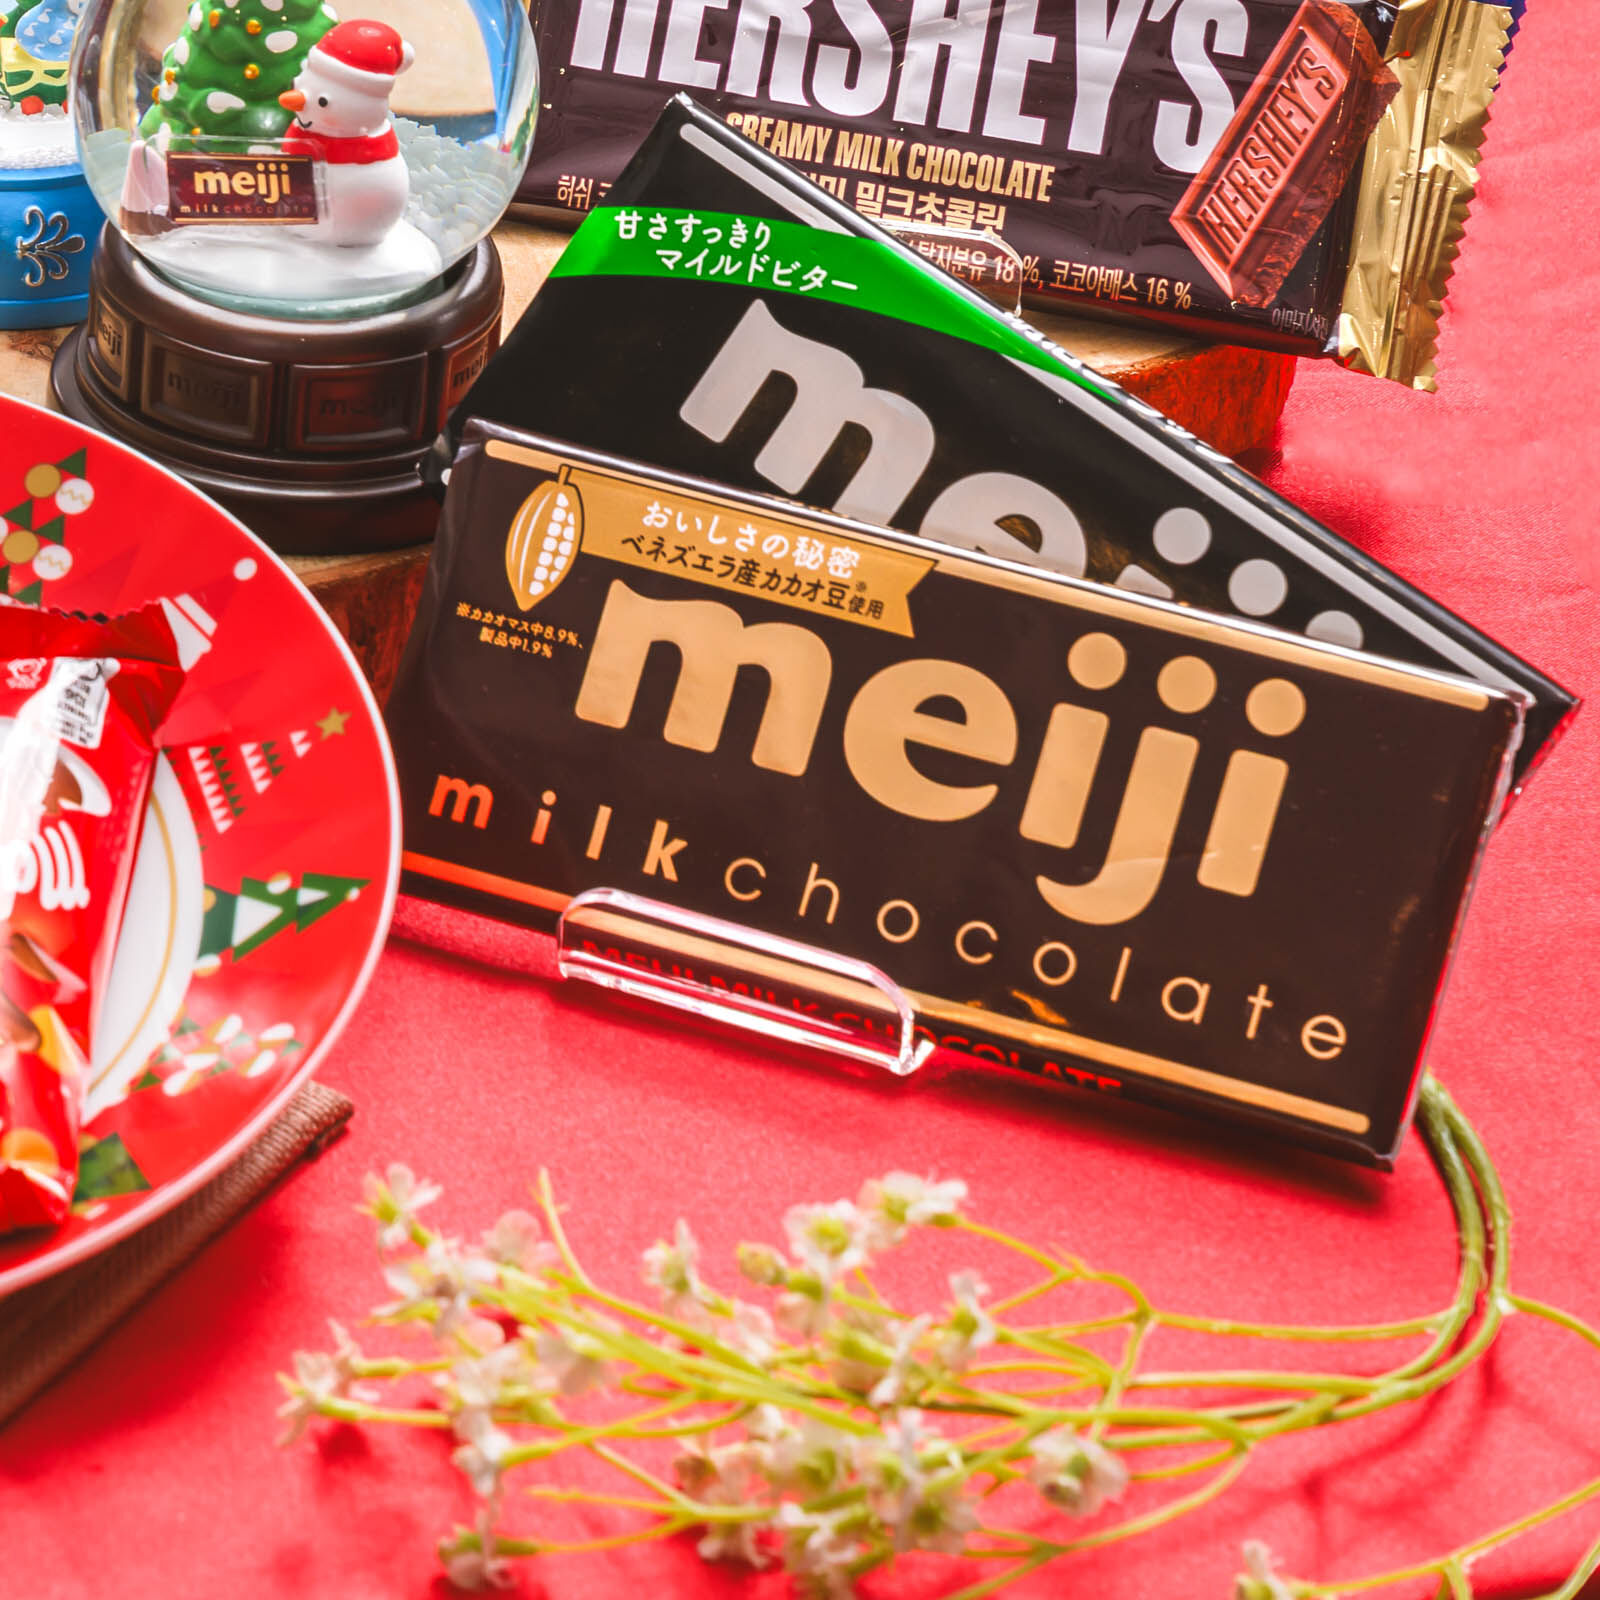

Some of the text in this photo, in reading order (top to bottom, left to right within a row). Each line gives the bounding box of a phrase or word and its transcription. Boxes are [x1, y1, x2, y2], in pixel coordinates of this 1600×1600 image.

[834, 131, 904, 178] MILK
[906, 142, 1056, 203] CHOCOLATE
[1198, 45, 1340, 259] HERSHEY'S
[194, 162, 291, 204] meiji
[557, 174, 595, 211] 허쉬
[614, 210, 772, 251] 甘さすっきり
[656, 248, 858, 292] マイルドビター
[1053, 259, 1138, 302] 코코아매스
[1146, 277, 1168, 305] 16
[1174, 283, 1192, 310] %
[642, 501, 861, 581] おいしさの秘密
[574, 576, 1308, 929] meiji
